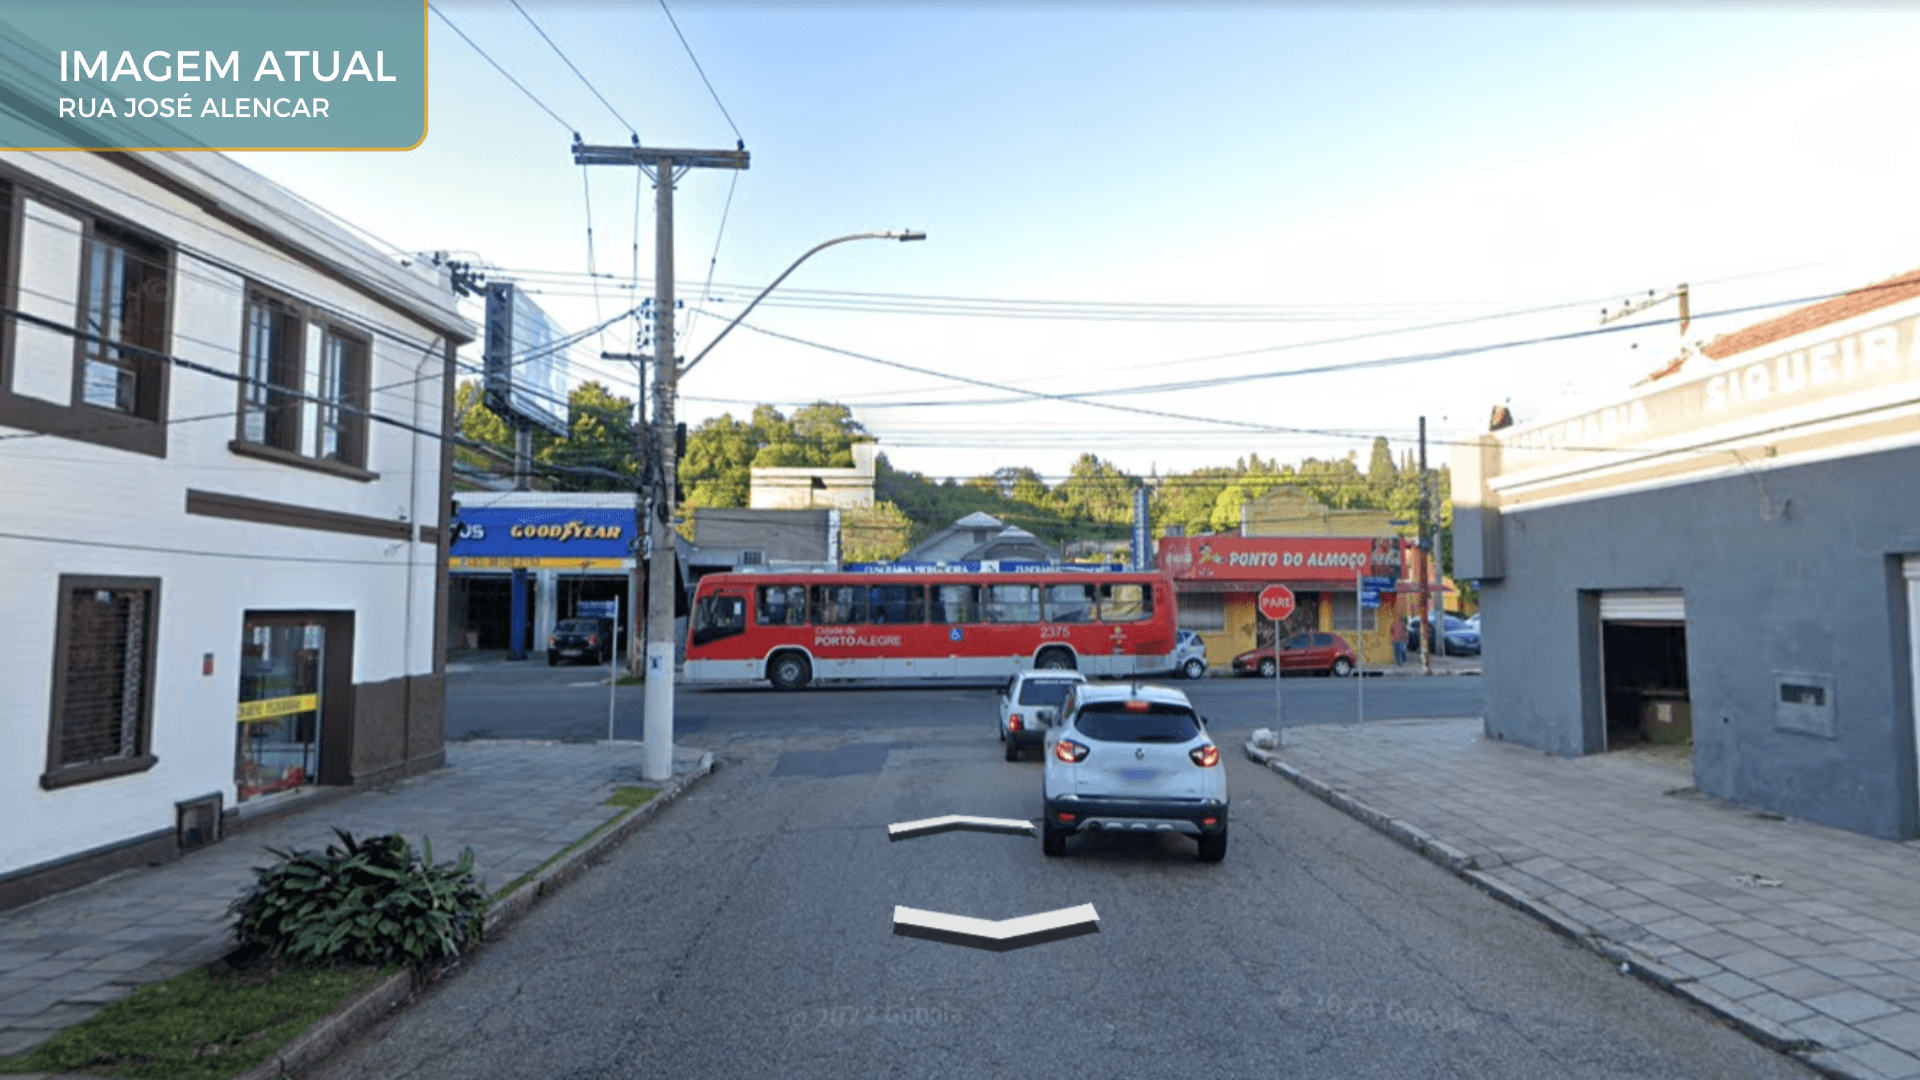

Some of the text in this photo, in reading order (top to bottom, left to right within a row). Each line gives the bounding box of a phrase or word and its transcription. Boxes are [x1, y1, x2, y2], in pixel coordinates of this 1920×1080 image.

[511, 521, 622, 542] GOODYEAR
[1229, 552, 1278, 566] PONTO
[1283, 552, 1303, 566] DO
[1307, 552, 1367, 569] ALMOÇO
[1262, 597, 1290, 608] PARE
